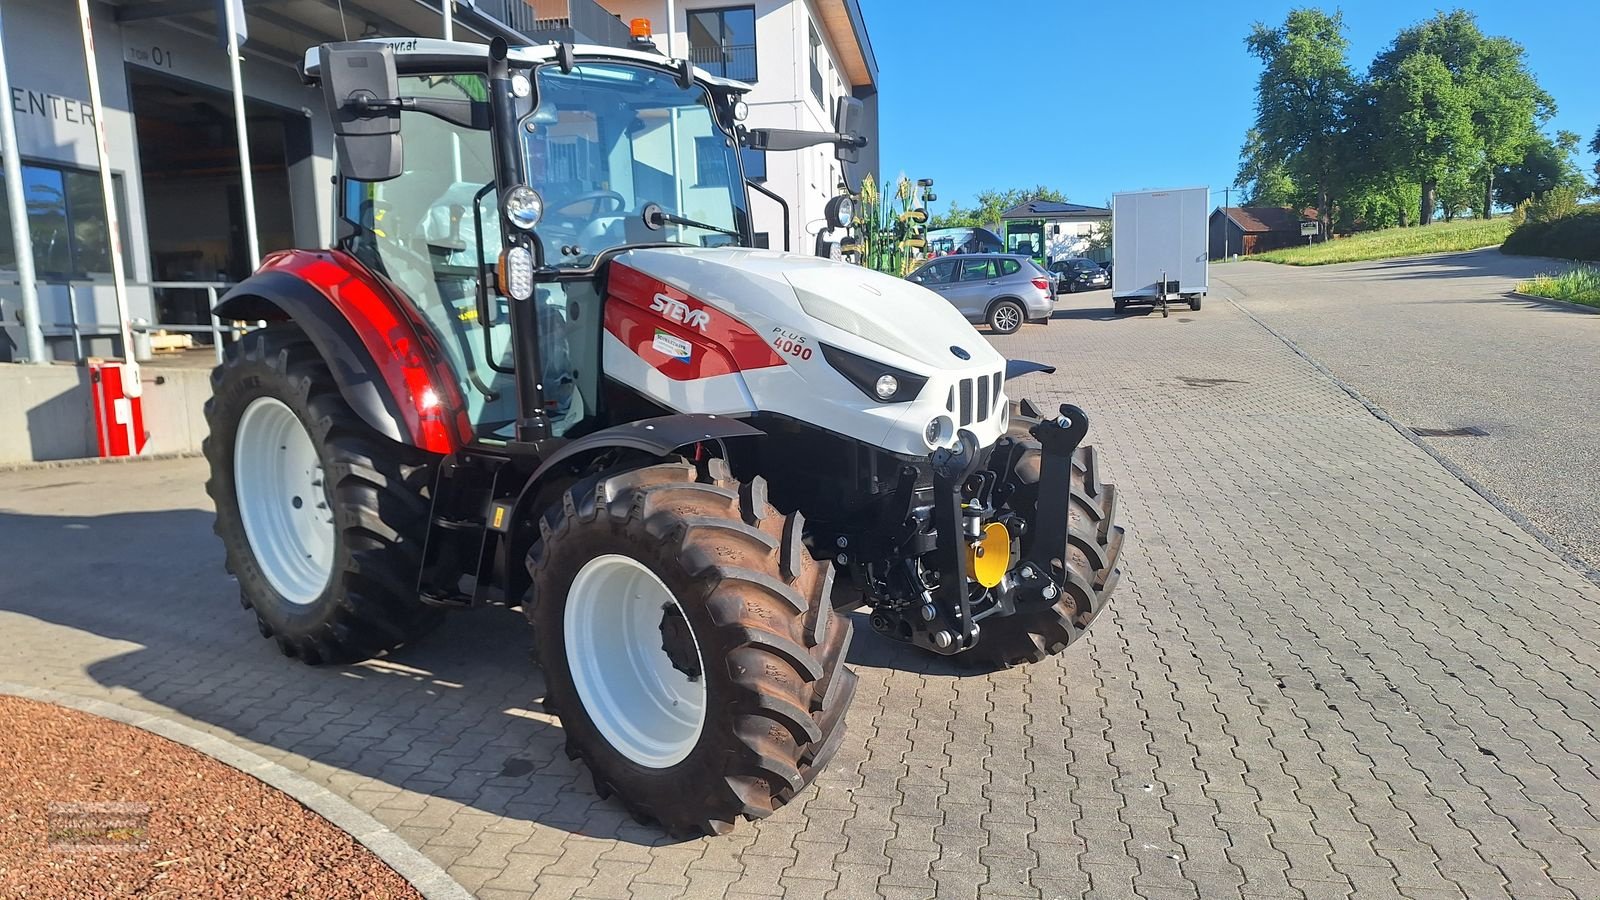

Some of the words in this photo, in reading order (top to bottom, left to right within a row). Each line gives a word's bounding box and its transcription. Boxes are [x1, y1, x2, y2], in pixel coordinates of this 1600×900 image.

[152, 46, 171, 68] 01
[649, 293, 710, 331] STEYR
[772, 326, 807, 343] PLUS
[774, 337, 812, 360] 4090
